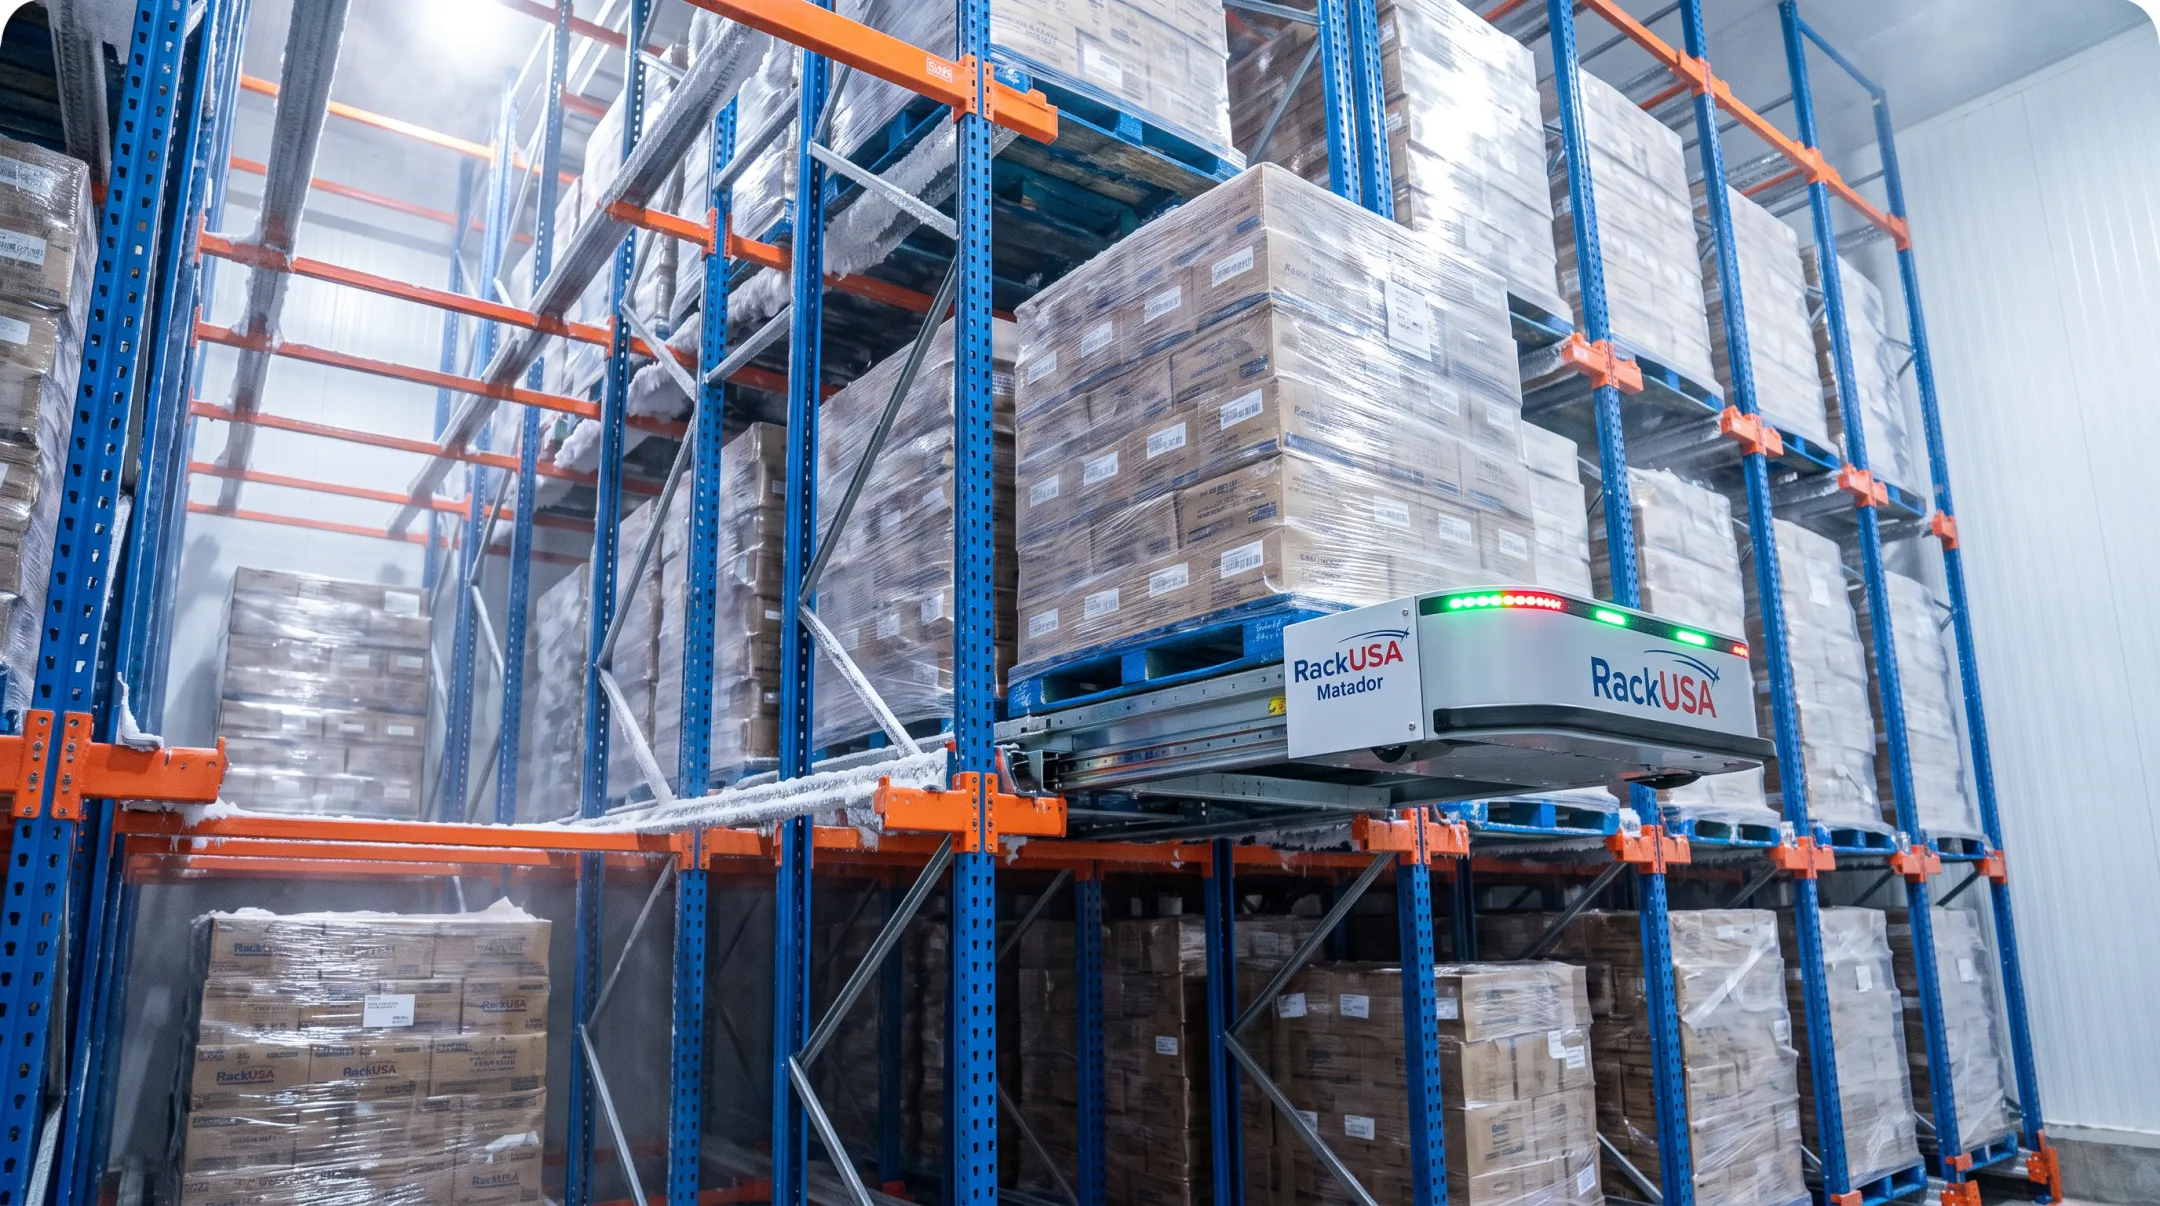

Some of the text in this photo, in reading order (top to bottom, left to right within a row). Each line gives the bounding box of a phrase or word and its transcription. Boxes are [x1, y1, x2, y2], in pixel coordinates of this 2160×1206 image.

[1294, 640, 1404, 683] RackUSA
[1317, 676, 1384, 701] Matador
[1591, 656, 1717, 718] RackUSA
[216, 1069, 275, 1082] RackUSA
[343, 1064, 396, 1077] RackUSA
